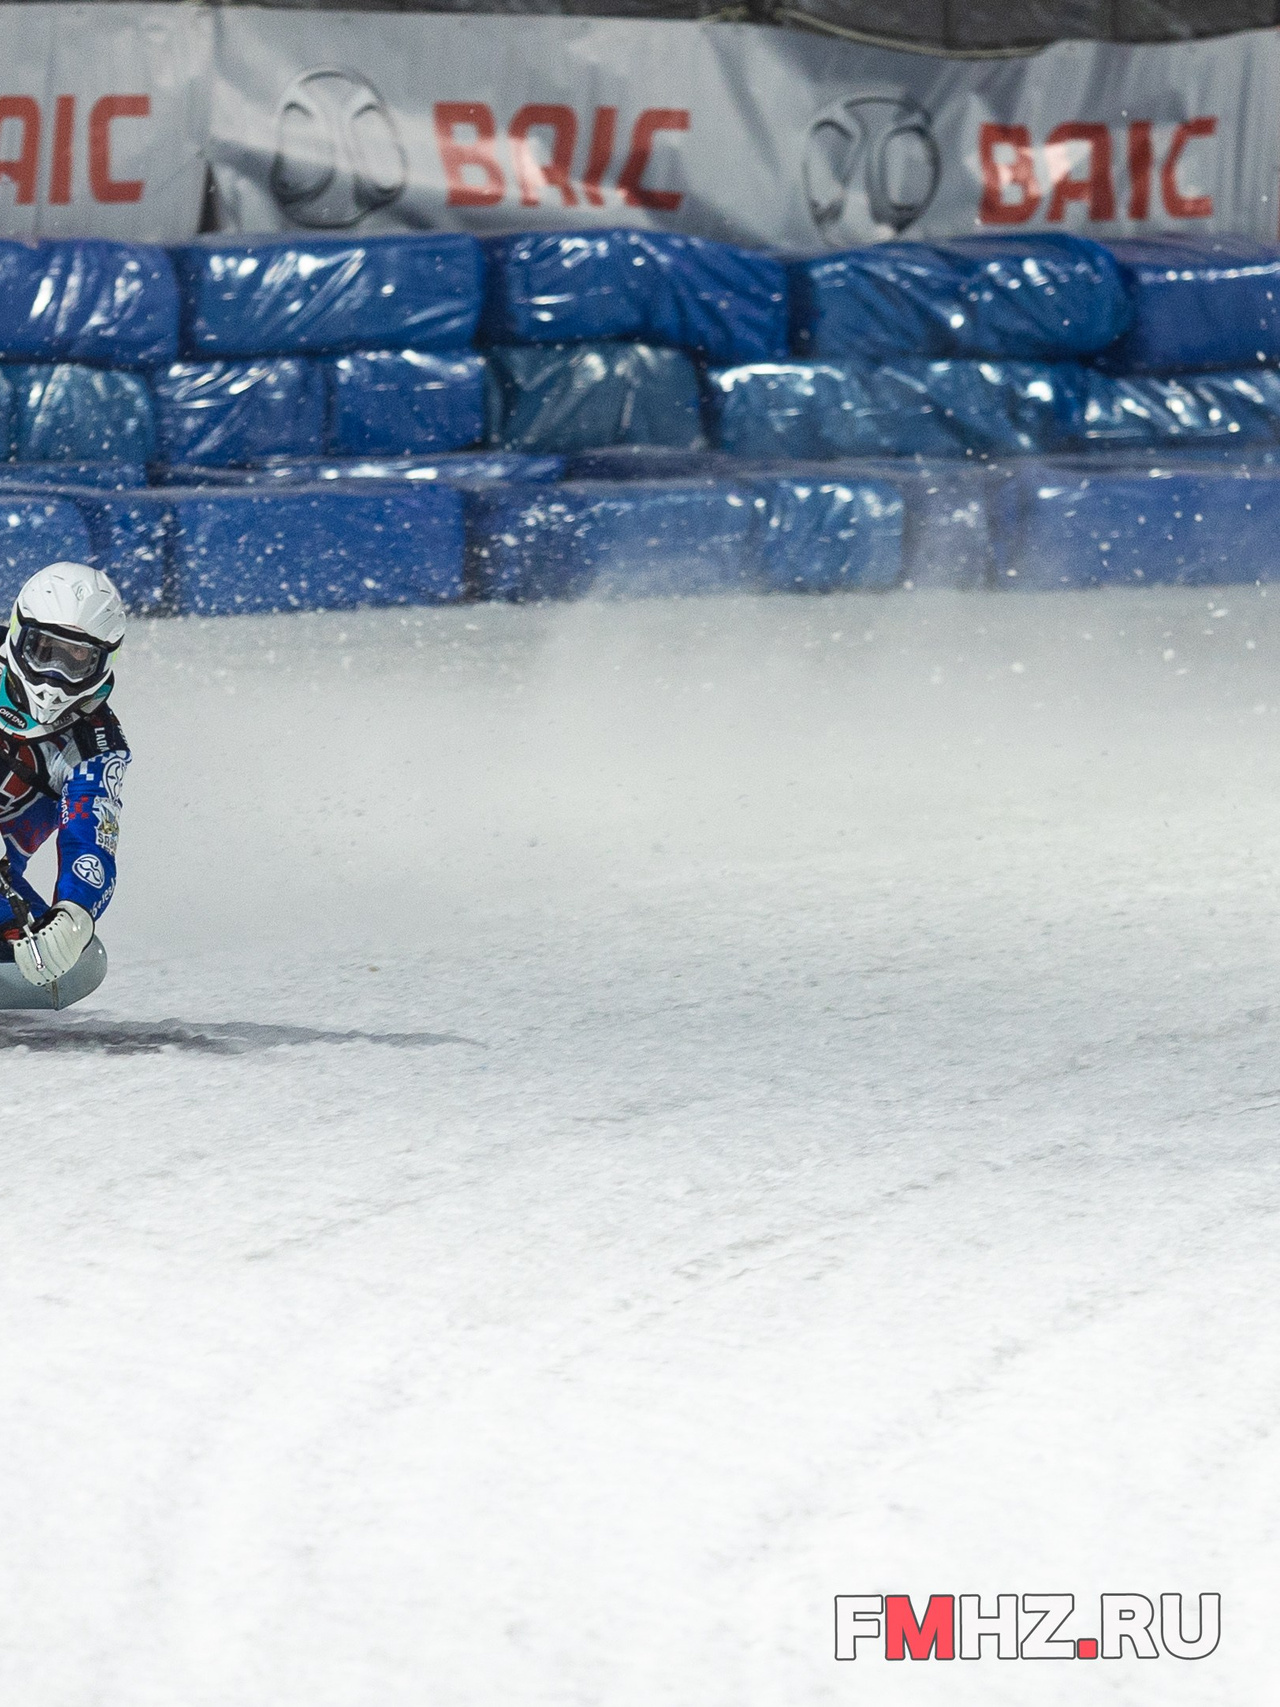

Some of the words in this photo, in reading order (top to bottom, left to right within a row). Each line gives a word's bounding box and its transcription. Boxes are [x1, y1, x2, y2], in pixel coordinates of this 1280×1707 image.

[433, 101, 690, 212] BAIC
[978, 116, 1218, 225] BAIC
[0, 708, 26, 729] ORTEMA
